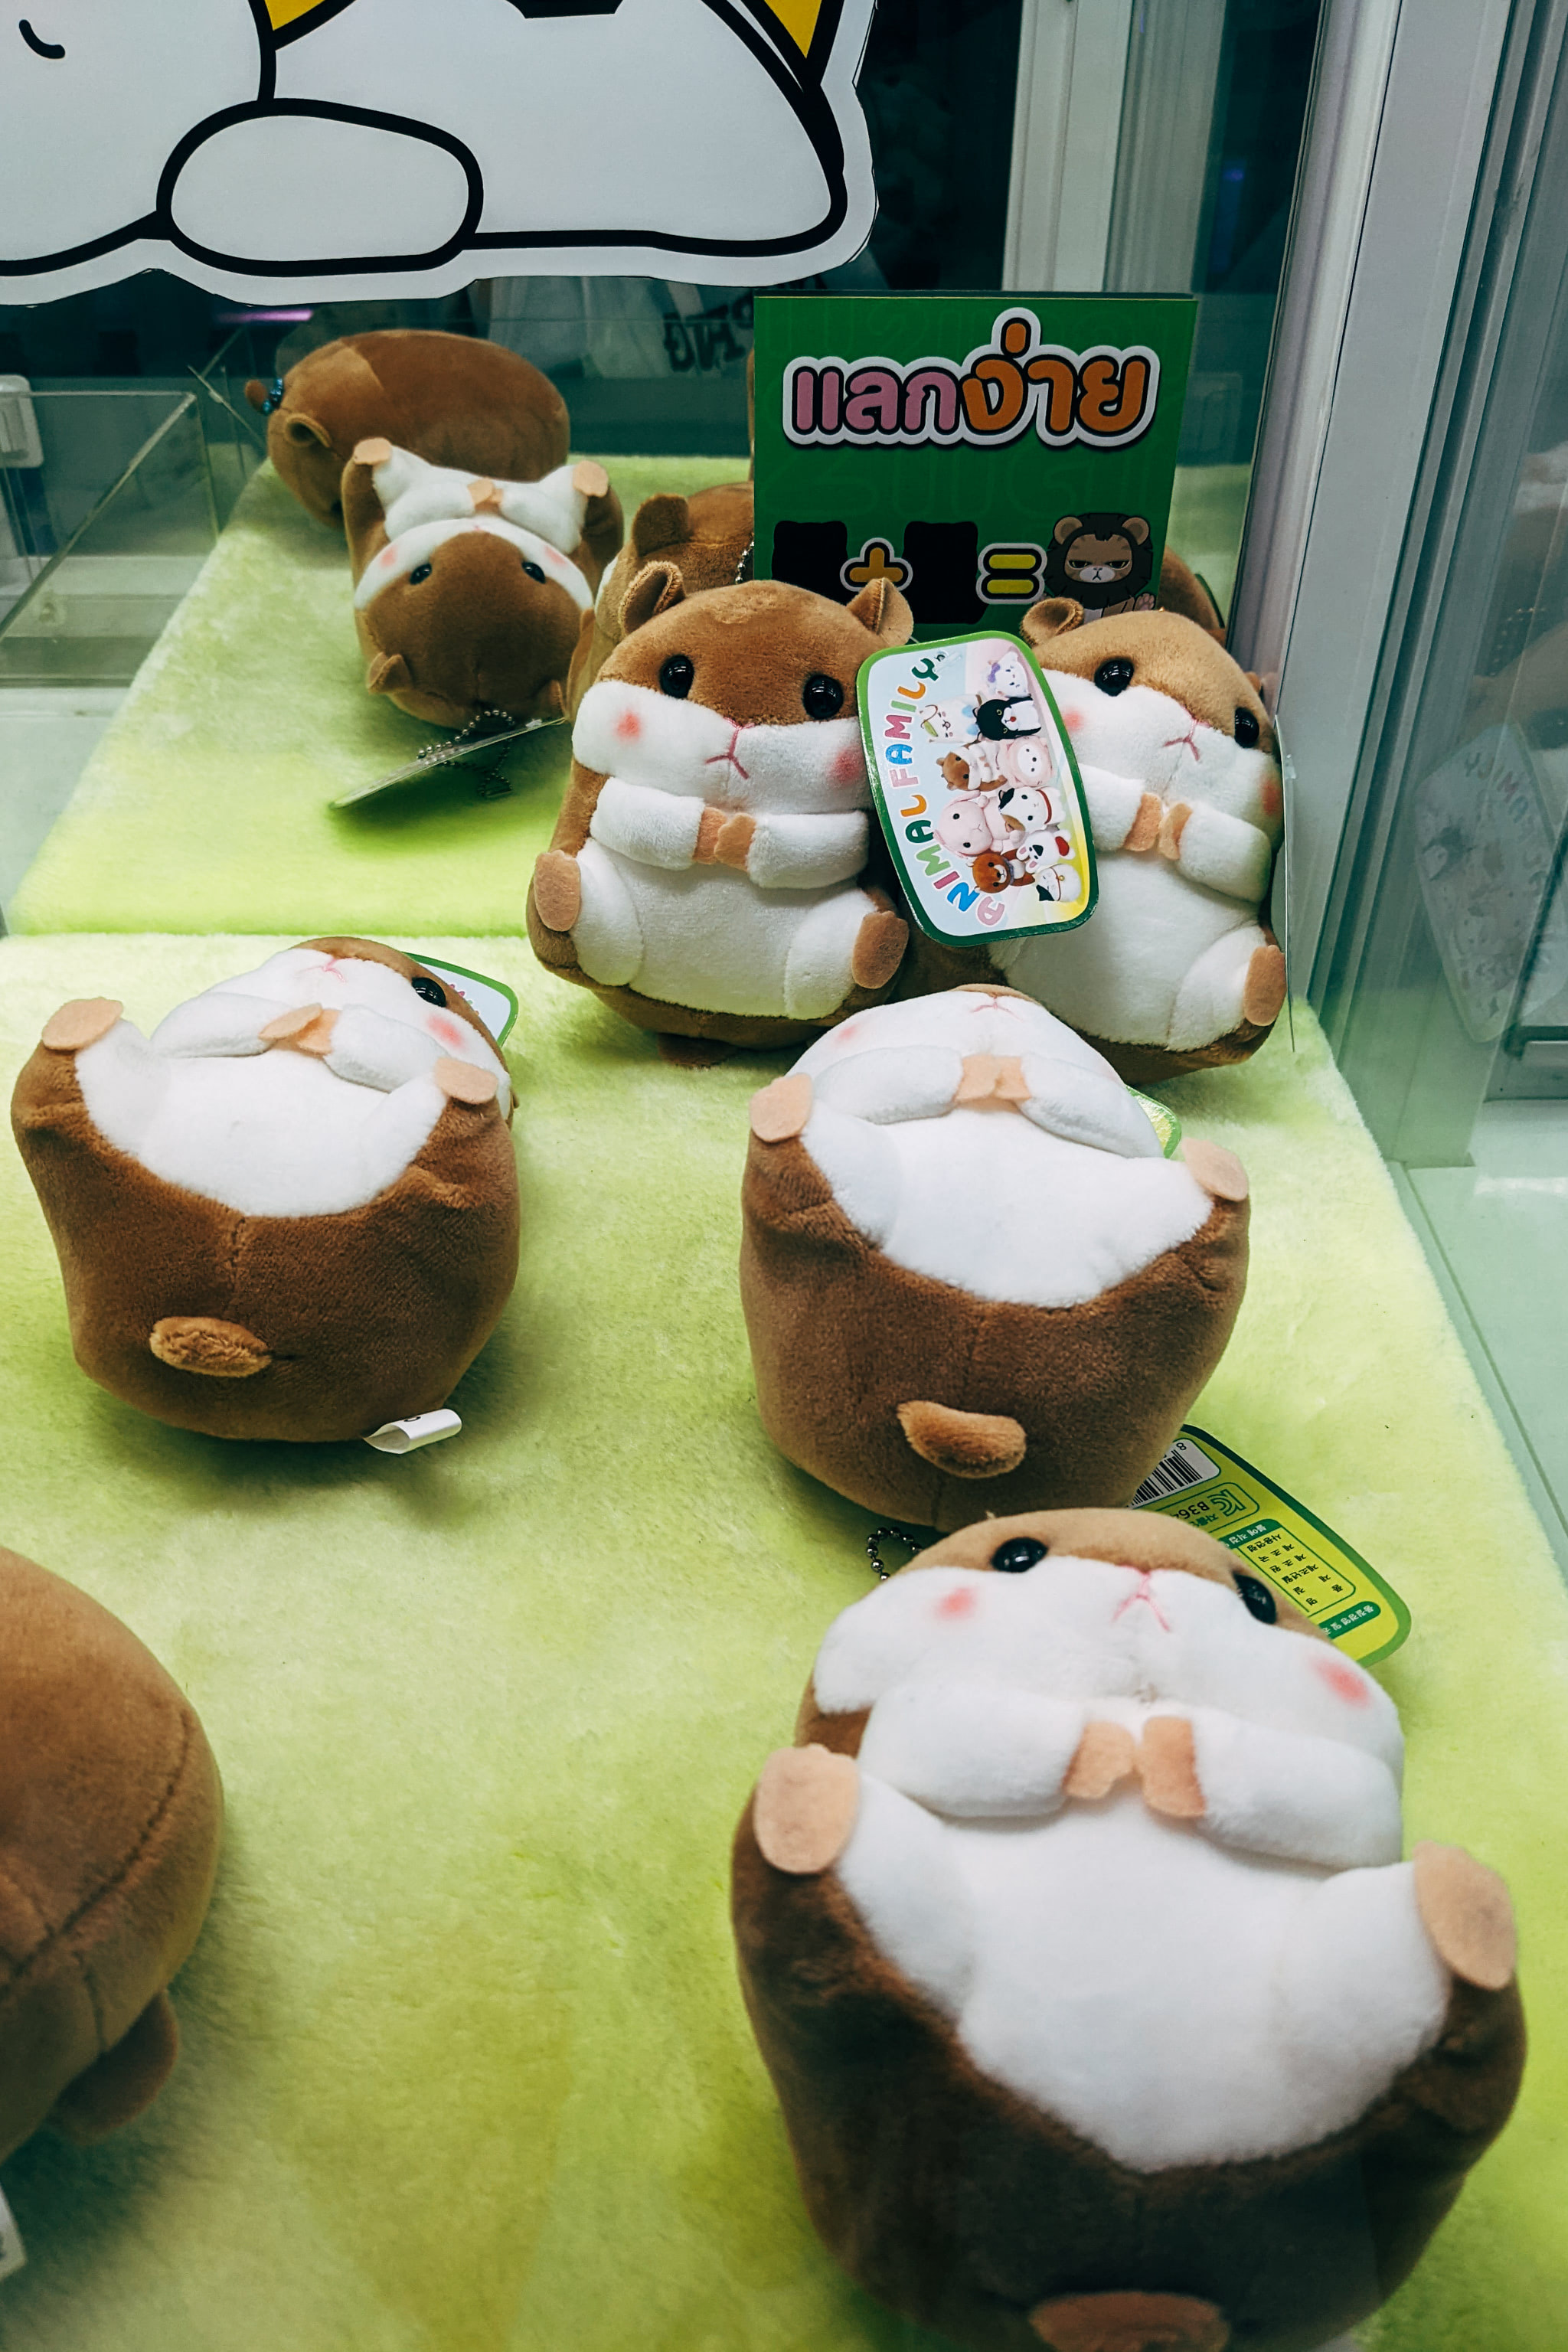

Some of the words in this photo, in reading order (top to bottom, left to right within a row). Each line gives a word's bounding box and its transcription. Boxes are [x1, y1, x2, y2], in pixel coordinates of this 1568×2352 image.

[788, 312, 1155, 442] แลกง่าย
[884, 658, 939, 788] FAMILY
[900, 793, 1005, 926] ANIMAL
[1228, 1534, 1248, 1544] 직접
[1246, 1534, 1282, 1553] 사용연령
[1340, 1605, 1374, 1626] 품질경영
